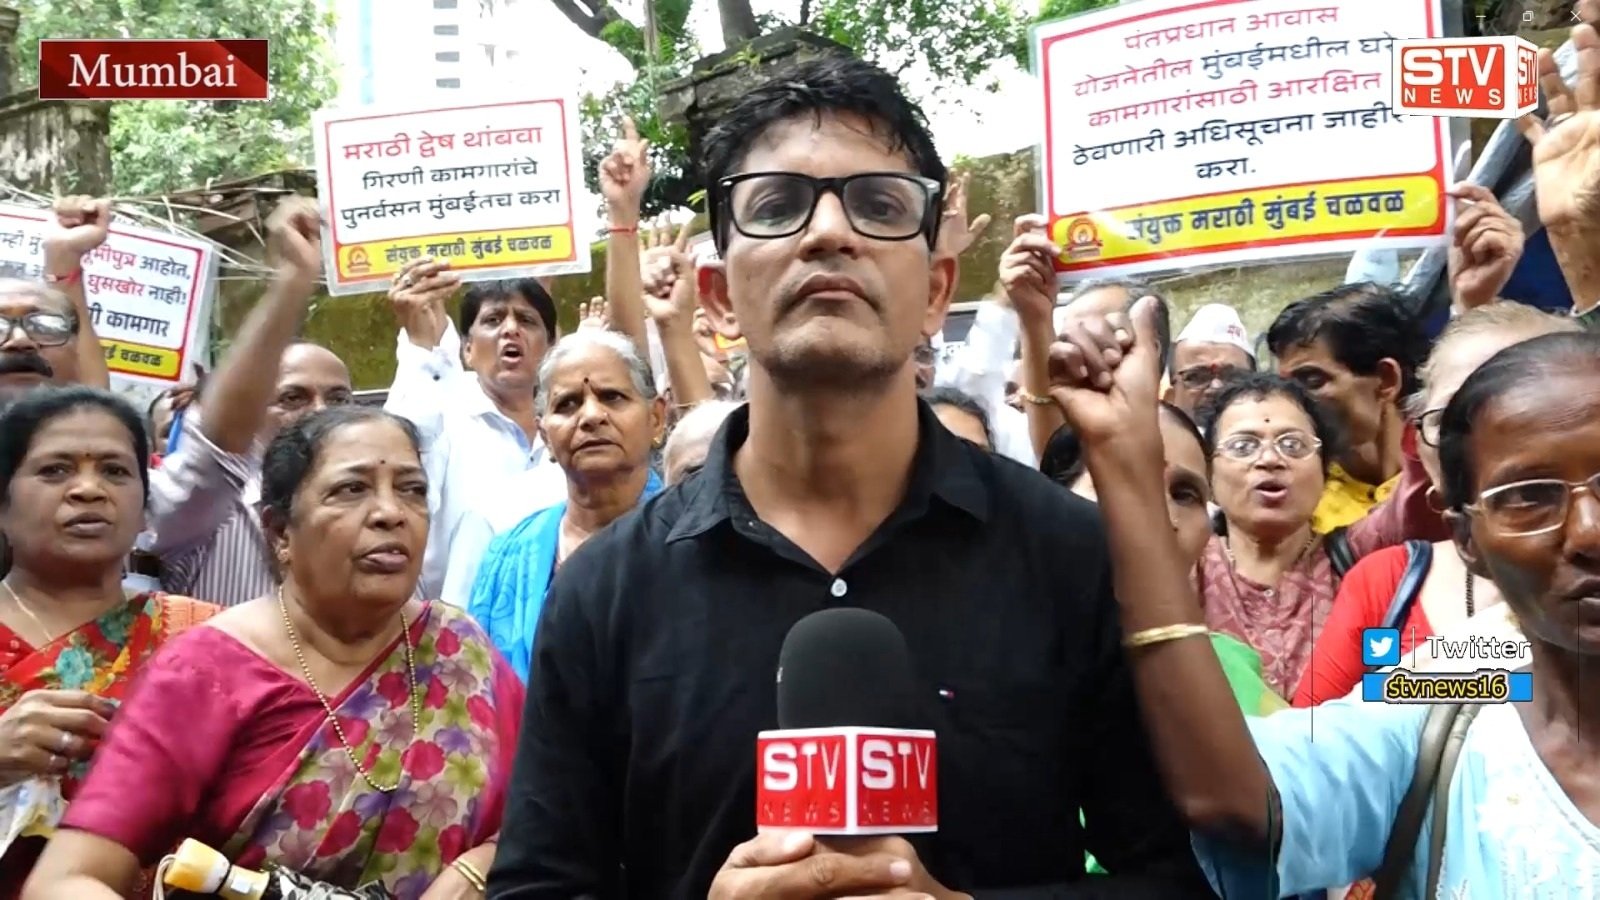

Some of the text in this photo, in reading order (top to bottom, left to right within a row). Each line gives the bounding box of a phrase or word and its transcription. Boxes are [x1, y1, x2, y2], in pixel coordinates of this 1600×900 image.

[1124, 6, 1340, 49] पंतप्रधान आवास
[1072, 57, 1193, 96] योजनेतील
[1200, 36, 1350, 80] मुंबईमधील
[1087, 69, 1382, 127] कामगारांसाठी आरक्षित
[343, 125, 543, 160] मराठी द्वेष थांबवा
[1072, 128, 1165, 166] ठेवणारी
[1174, 114, 1315, 149] अधिसूचना
[363, 157, 538, 190] गिरणी कामगारांचे
[1194, 157, 1256, 179] करा.
[341, 188, 561, 228] पुनर्वसन मुंबईतच करा
[1189, 197, 1255, 230] मराठी
[1262, 190, 1317, 230] मुंबई
[1323, 190, 1405, 217] चळवळ
[426, 237, 466, 257] मराठी
[471, 234, 503, 260] मुंबई
[506, 234, 553, 252] चळवळ
[88, 273, 187, 305] घुसखोर नाही!
[106, 309, 170, 337] कामगार
[120, 348, 163, 367] चळवळ
[763, 741, 841, 791] STV
[862, 739, 931, 790] STV
